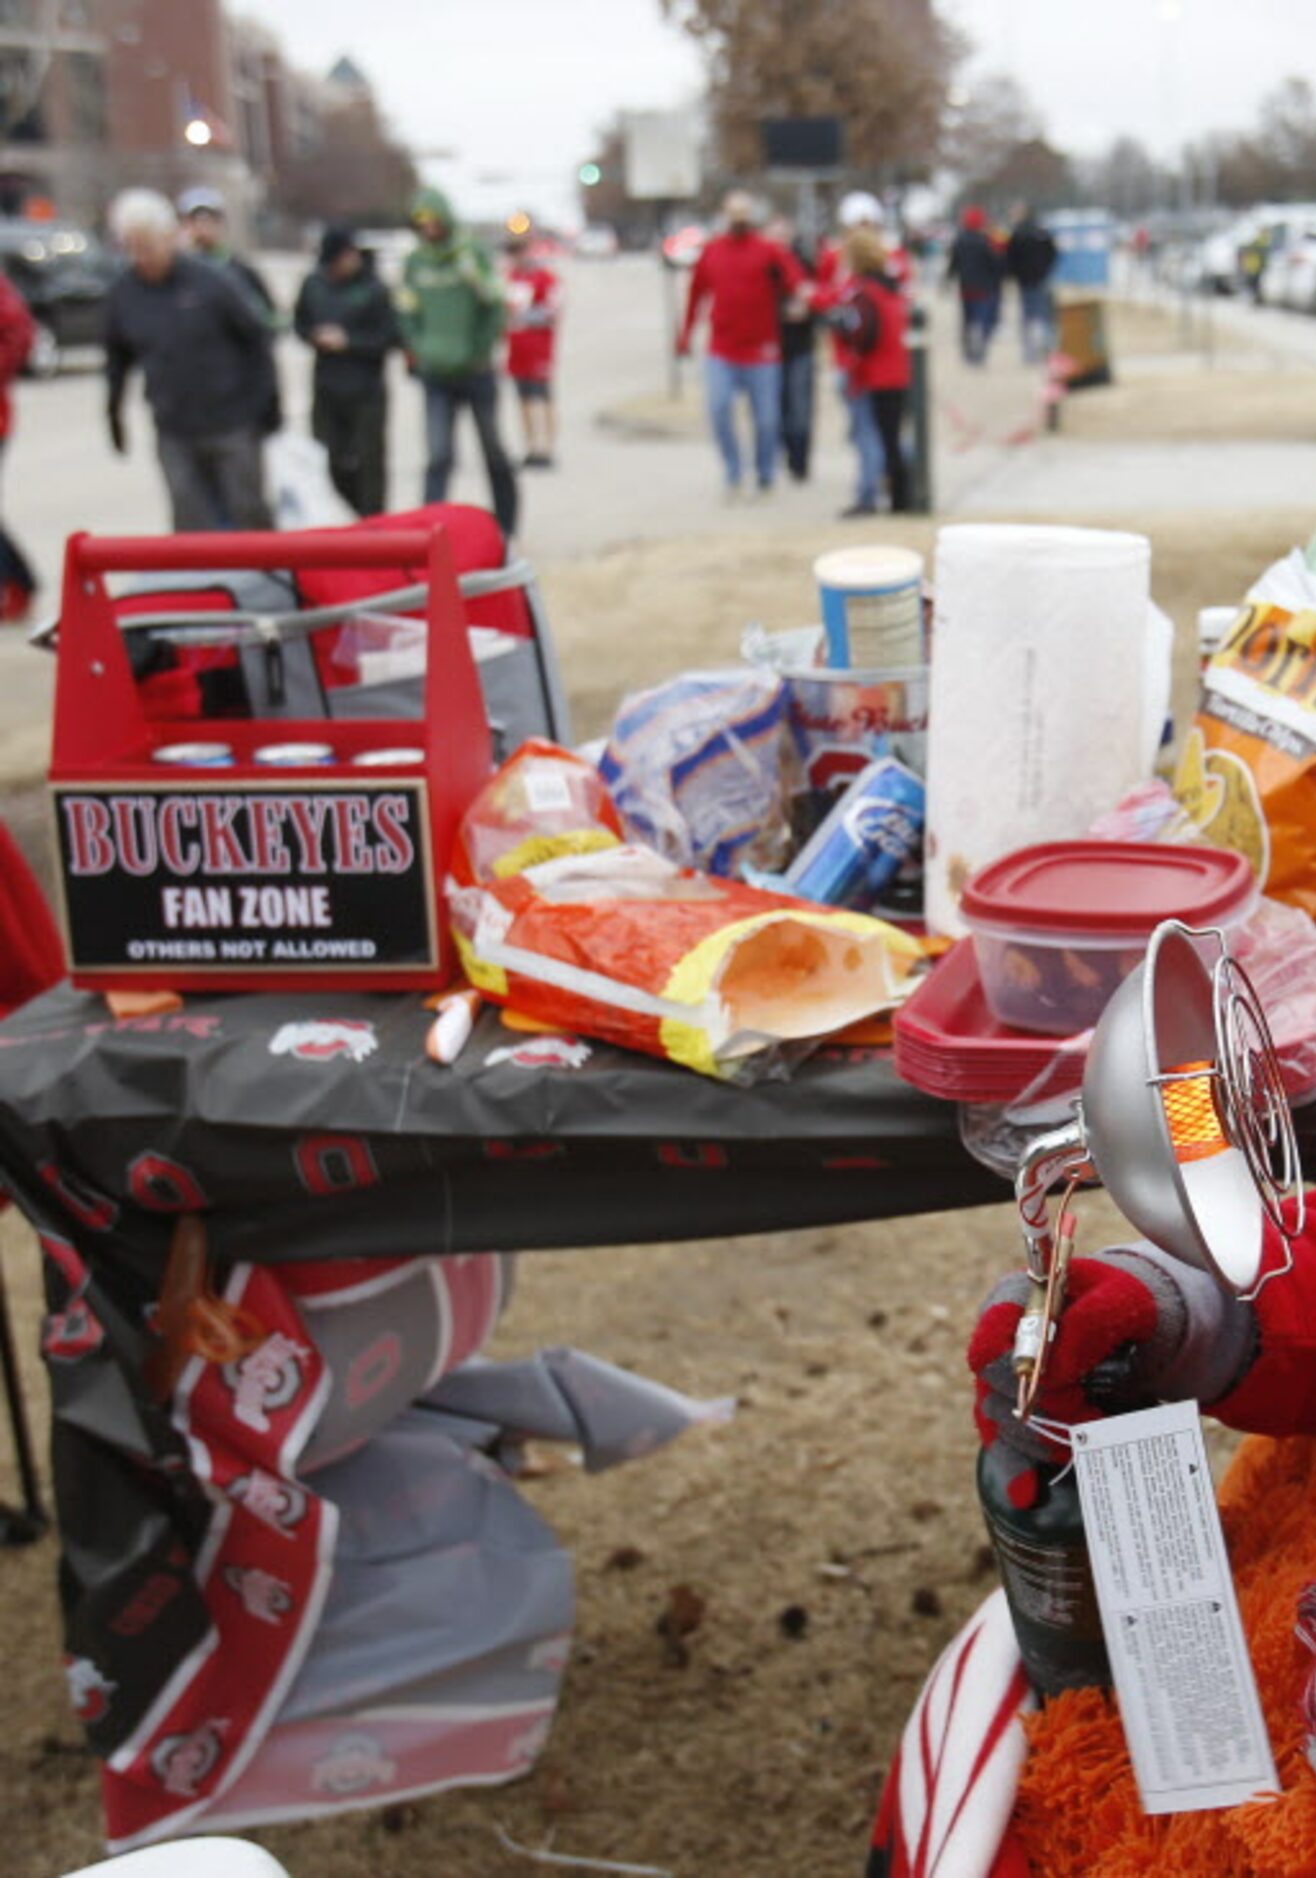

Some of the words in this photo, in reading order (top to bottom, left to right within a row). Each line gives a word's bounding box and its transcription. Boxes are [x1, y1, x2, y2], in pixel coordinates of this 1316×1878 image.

[63, 794, 414, 876] BUCKEYES
[162, 886, 232, 927] FAN
[238, 886, 332, 927] ZONE
[127, 939, 216, 959] OTHERS
[220, 939, 267, 958] NOT
[272, 939, 377, 958] ALLOWED
